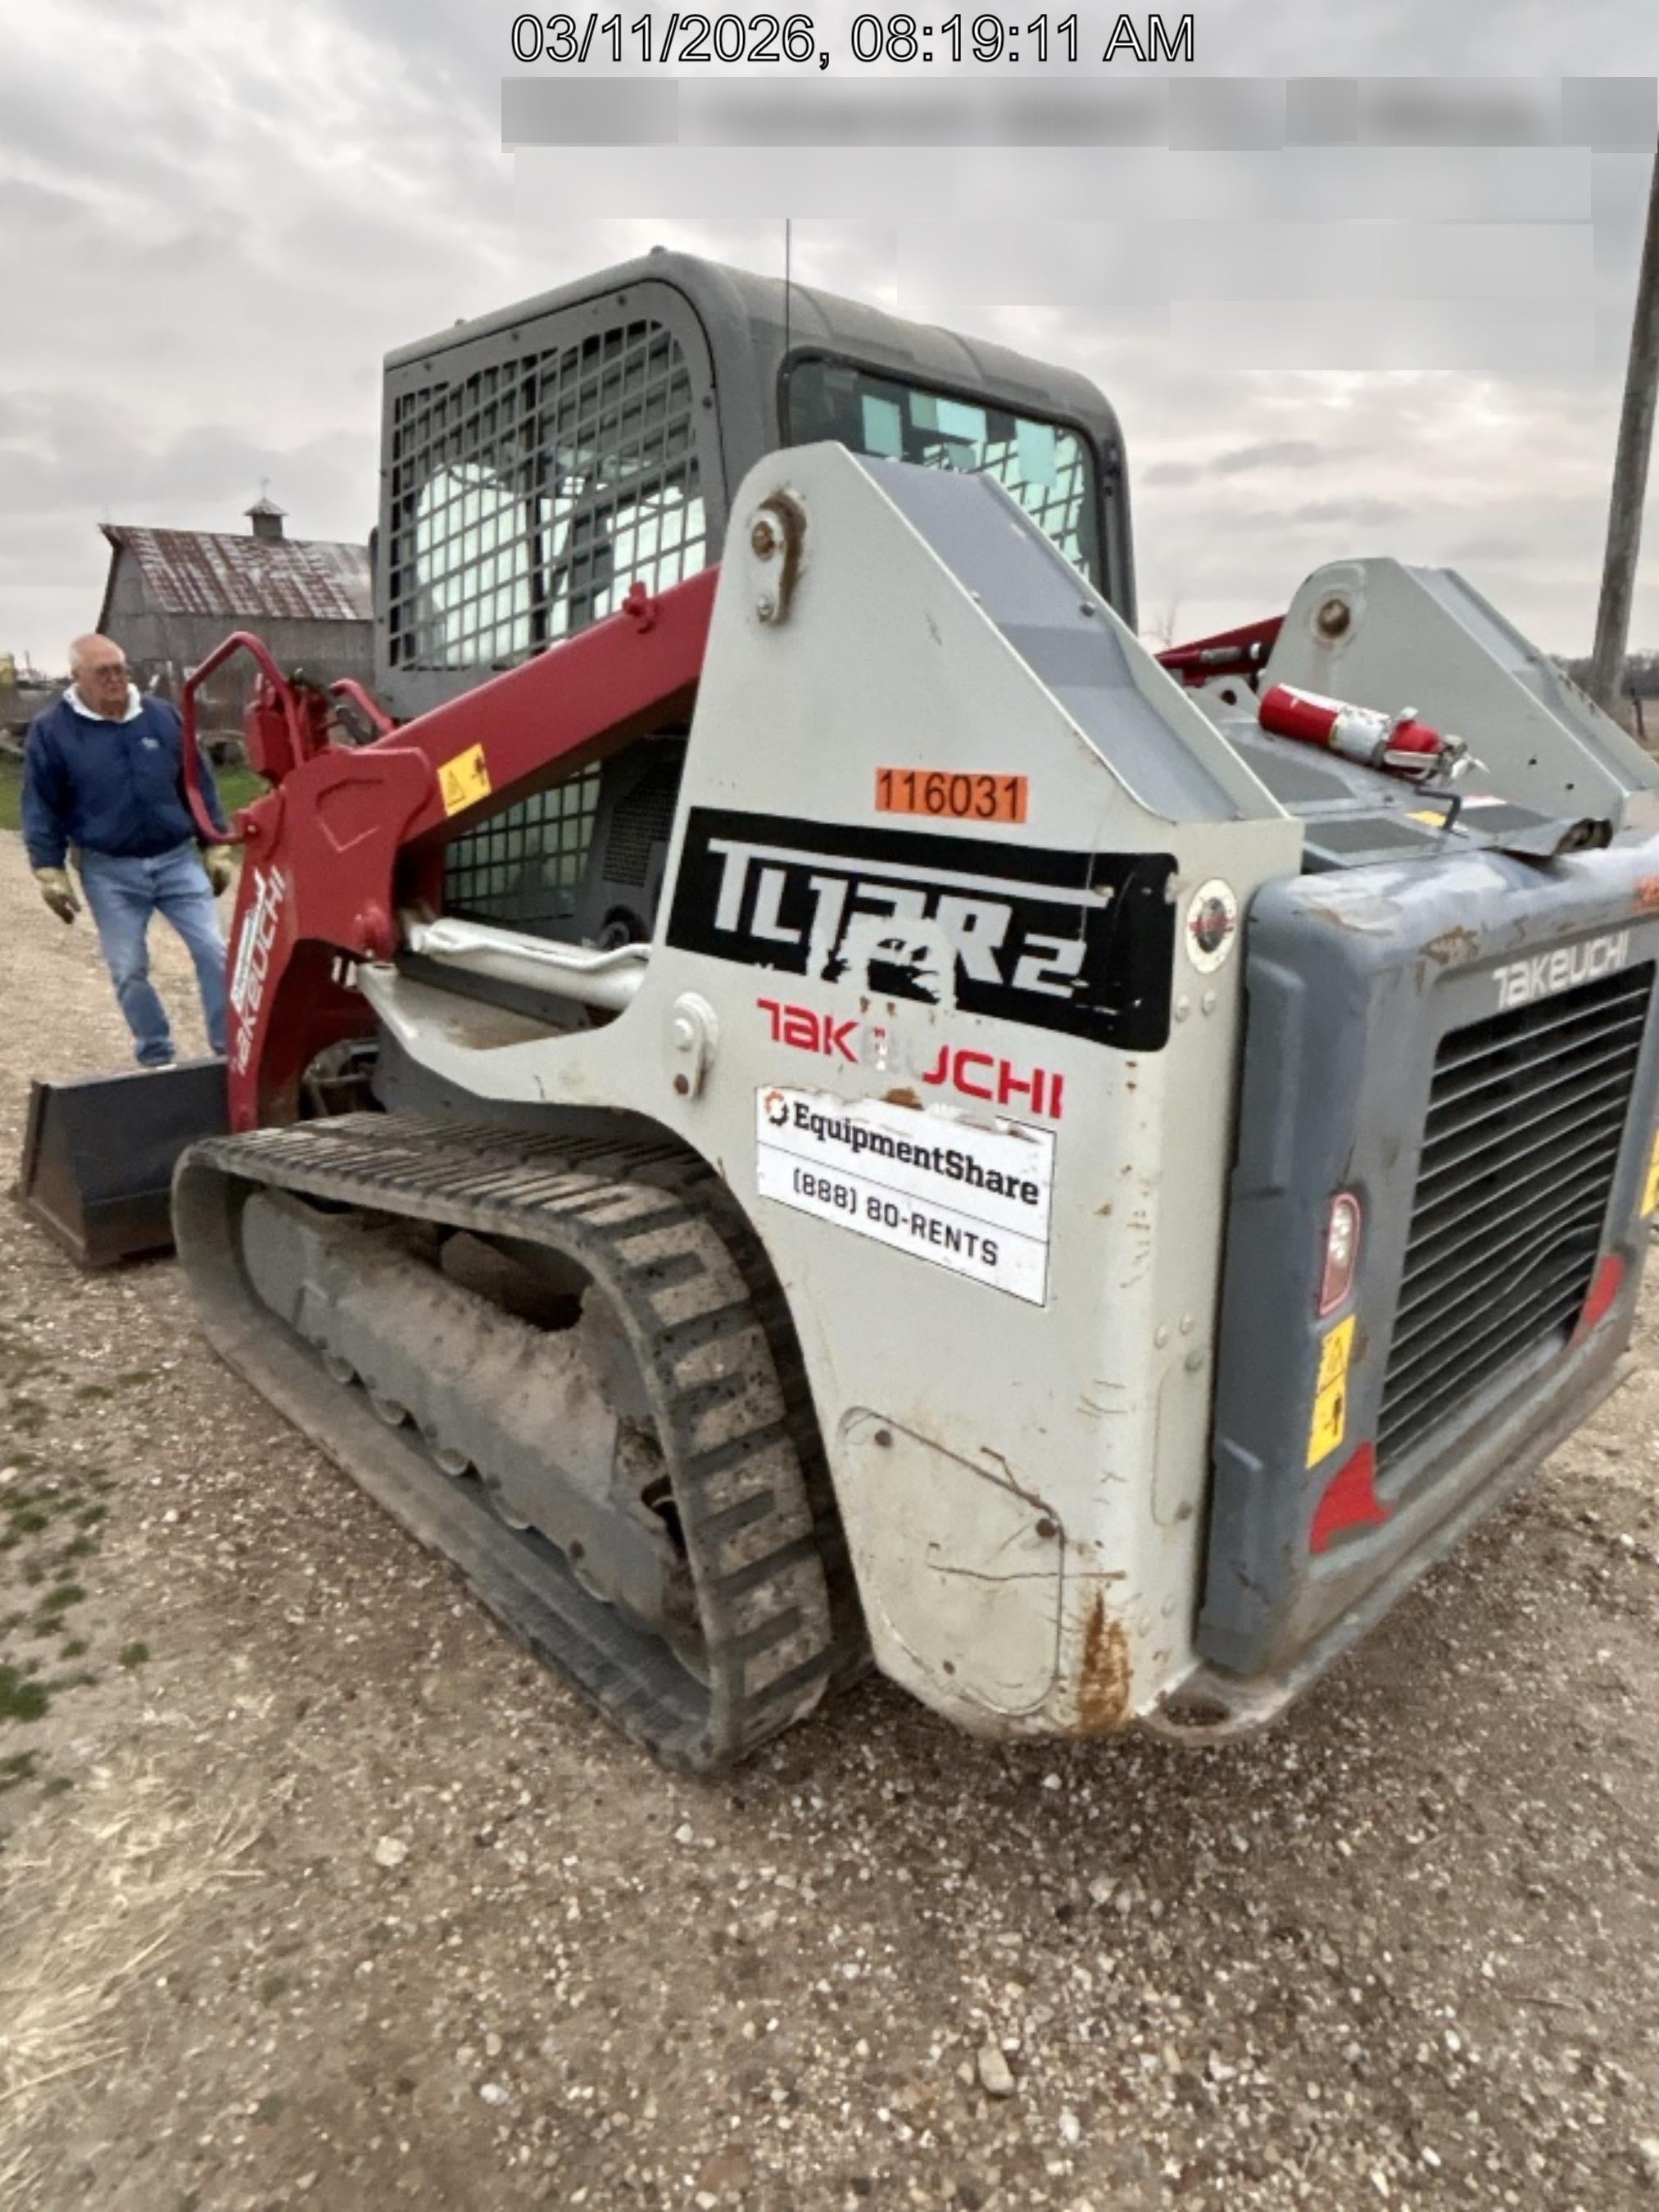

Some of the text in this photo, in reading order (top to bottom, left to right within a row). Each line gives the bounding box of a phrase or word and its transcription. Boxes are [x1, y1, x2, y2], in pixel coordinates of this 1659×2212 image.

[879, 768, 1018, 820] 116031
[1492, 929, 1630, 1010] TAKEUCHI
[756, 997, 1064, 1119] TAKUCHI
[792, 1100, 1039, 1206] EquipmentShare
[792, 1167, 999, 1267] (888) 80-RENTS
